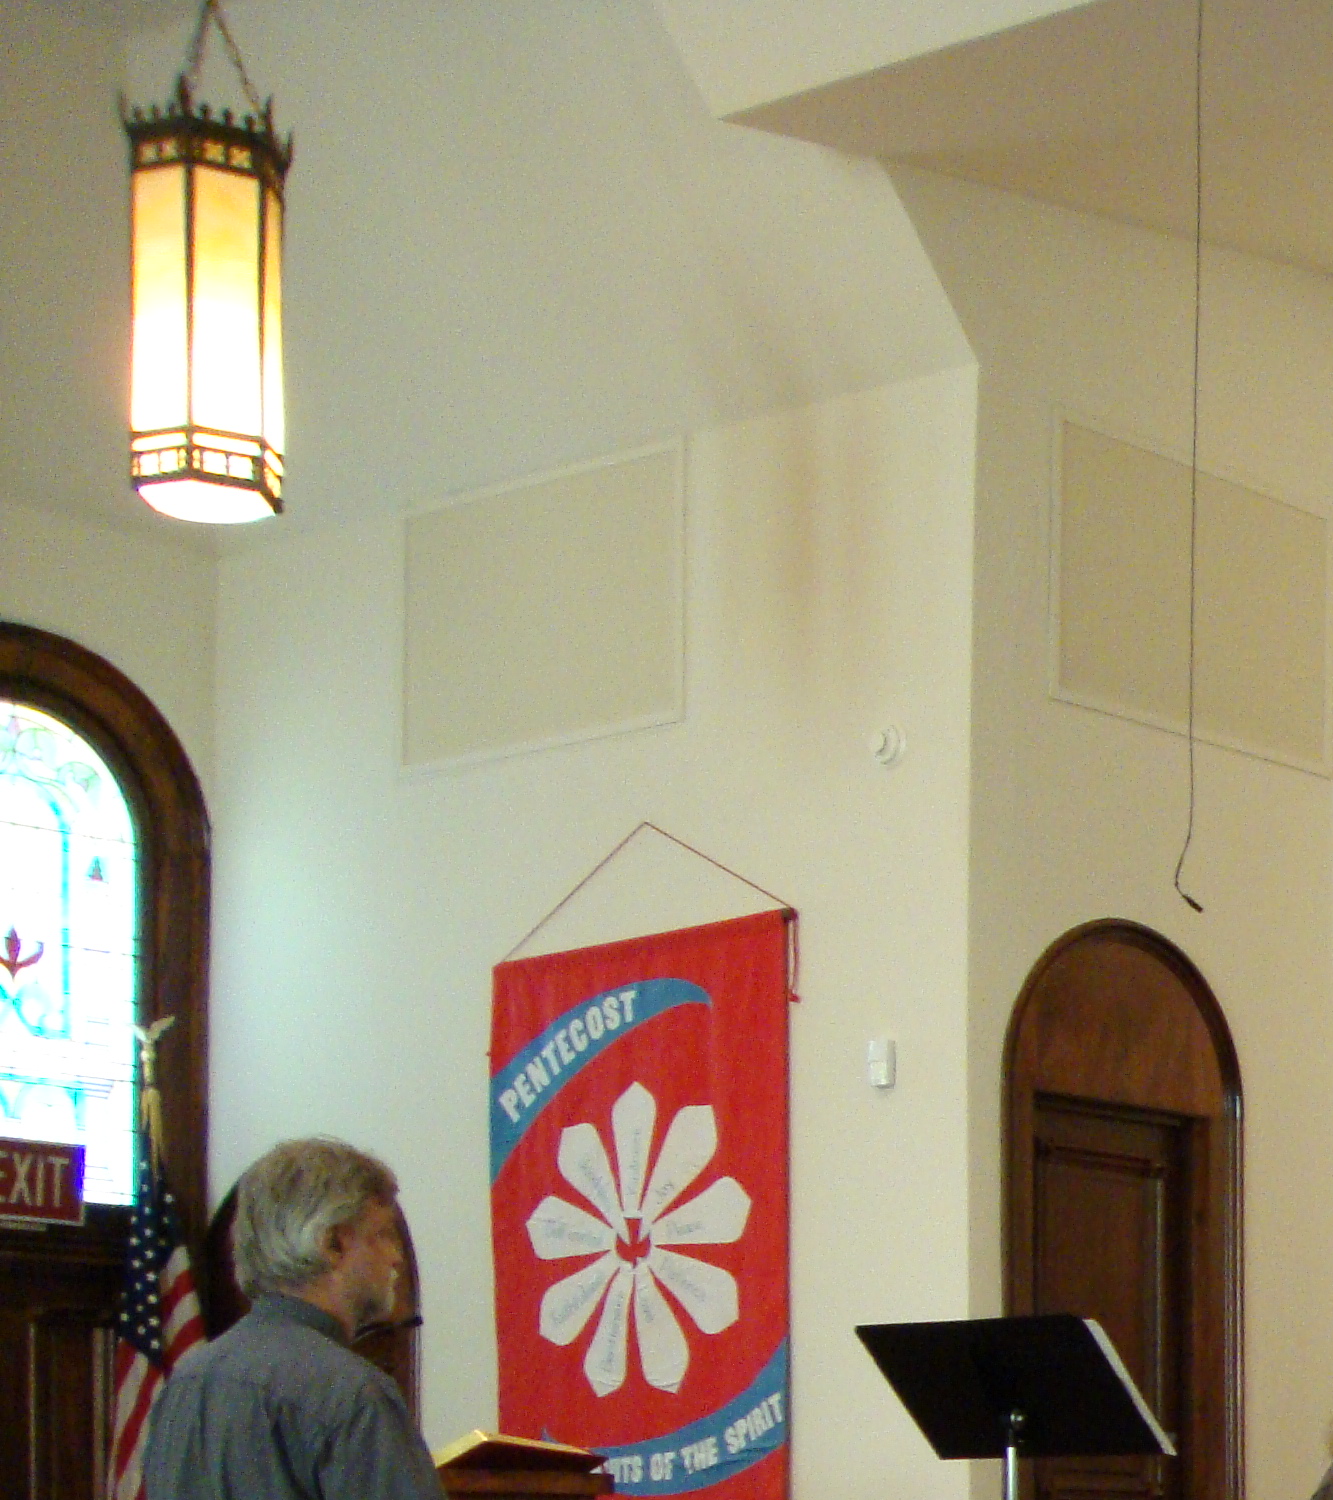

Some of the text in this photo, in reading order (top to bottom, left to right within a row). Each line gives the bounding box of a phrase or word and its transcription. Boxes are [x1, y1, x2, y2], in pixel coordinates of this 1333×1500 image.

[498, 989, 638, 1124] PENTECOST
[650, 1452, 676, 1481] OF
[680, 1436, 719, 1475] THE
[724, 1392, 785, 1455] SPIRIT
